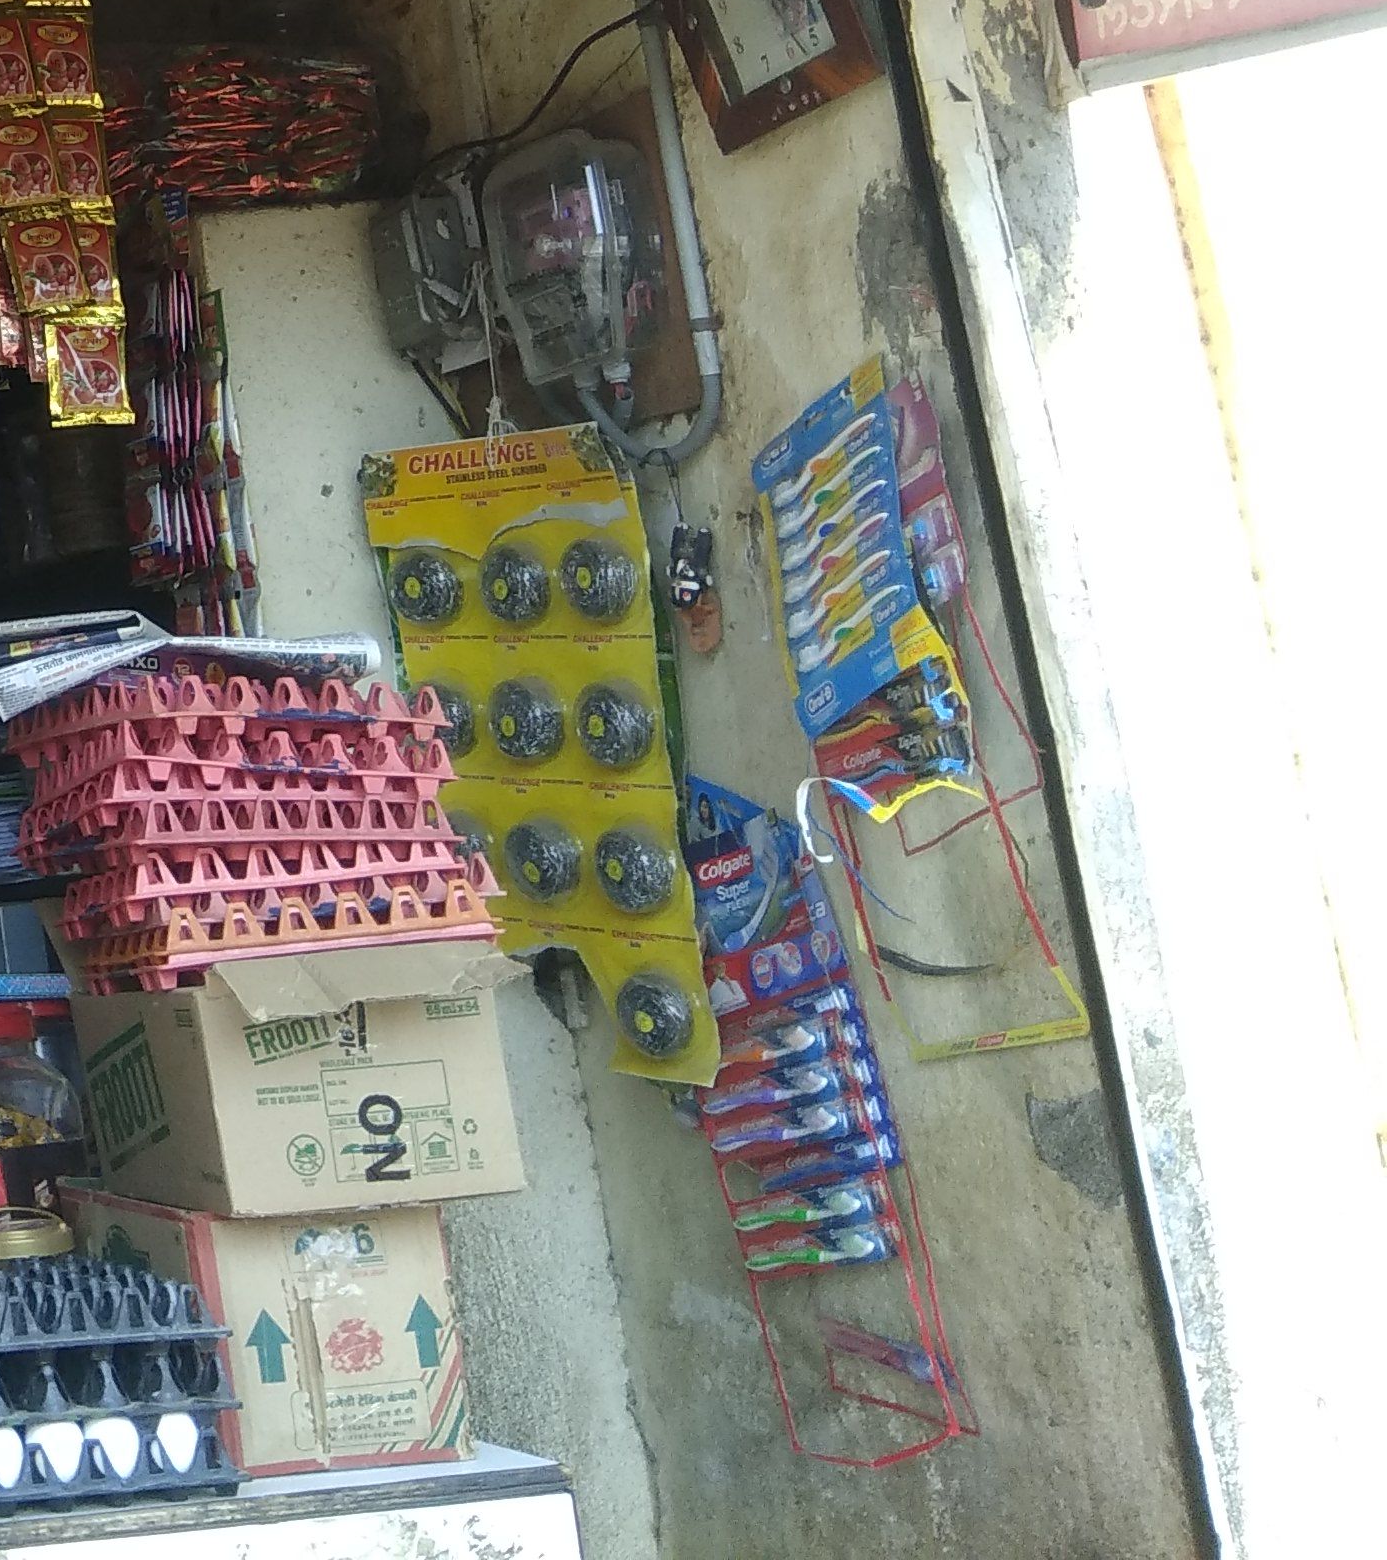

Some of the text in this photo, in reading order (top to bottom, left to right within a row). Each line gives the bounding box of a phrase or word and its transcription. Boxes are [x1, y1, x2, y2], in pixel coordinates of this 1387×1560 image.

[733, 36, 745, 55] 8
[408, 441, 537, 475] CHALLENGE
[445, 469, 487, 485] STAINLESS
[487, 466, 511, 481] STEEL
[806, 685, 835, 716] Oral-B
[842, 745, 883, 771] Colgate
[698, 850, 754, 884] Colgate
[715, 878, 753, 903] Super
